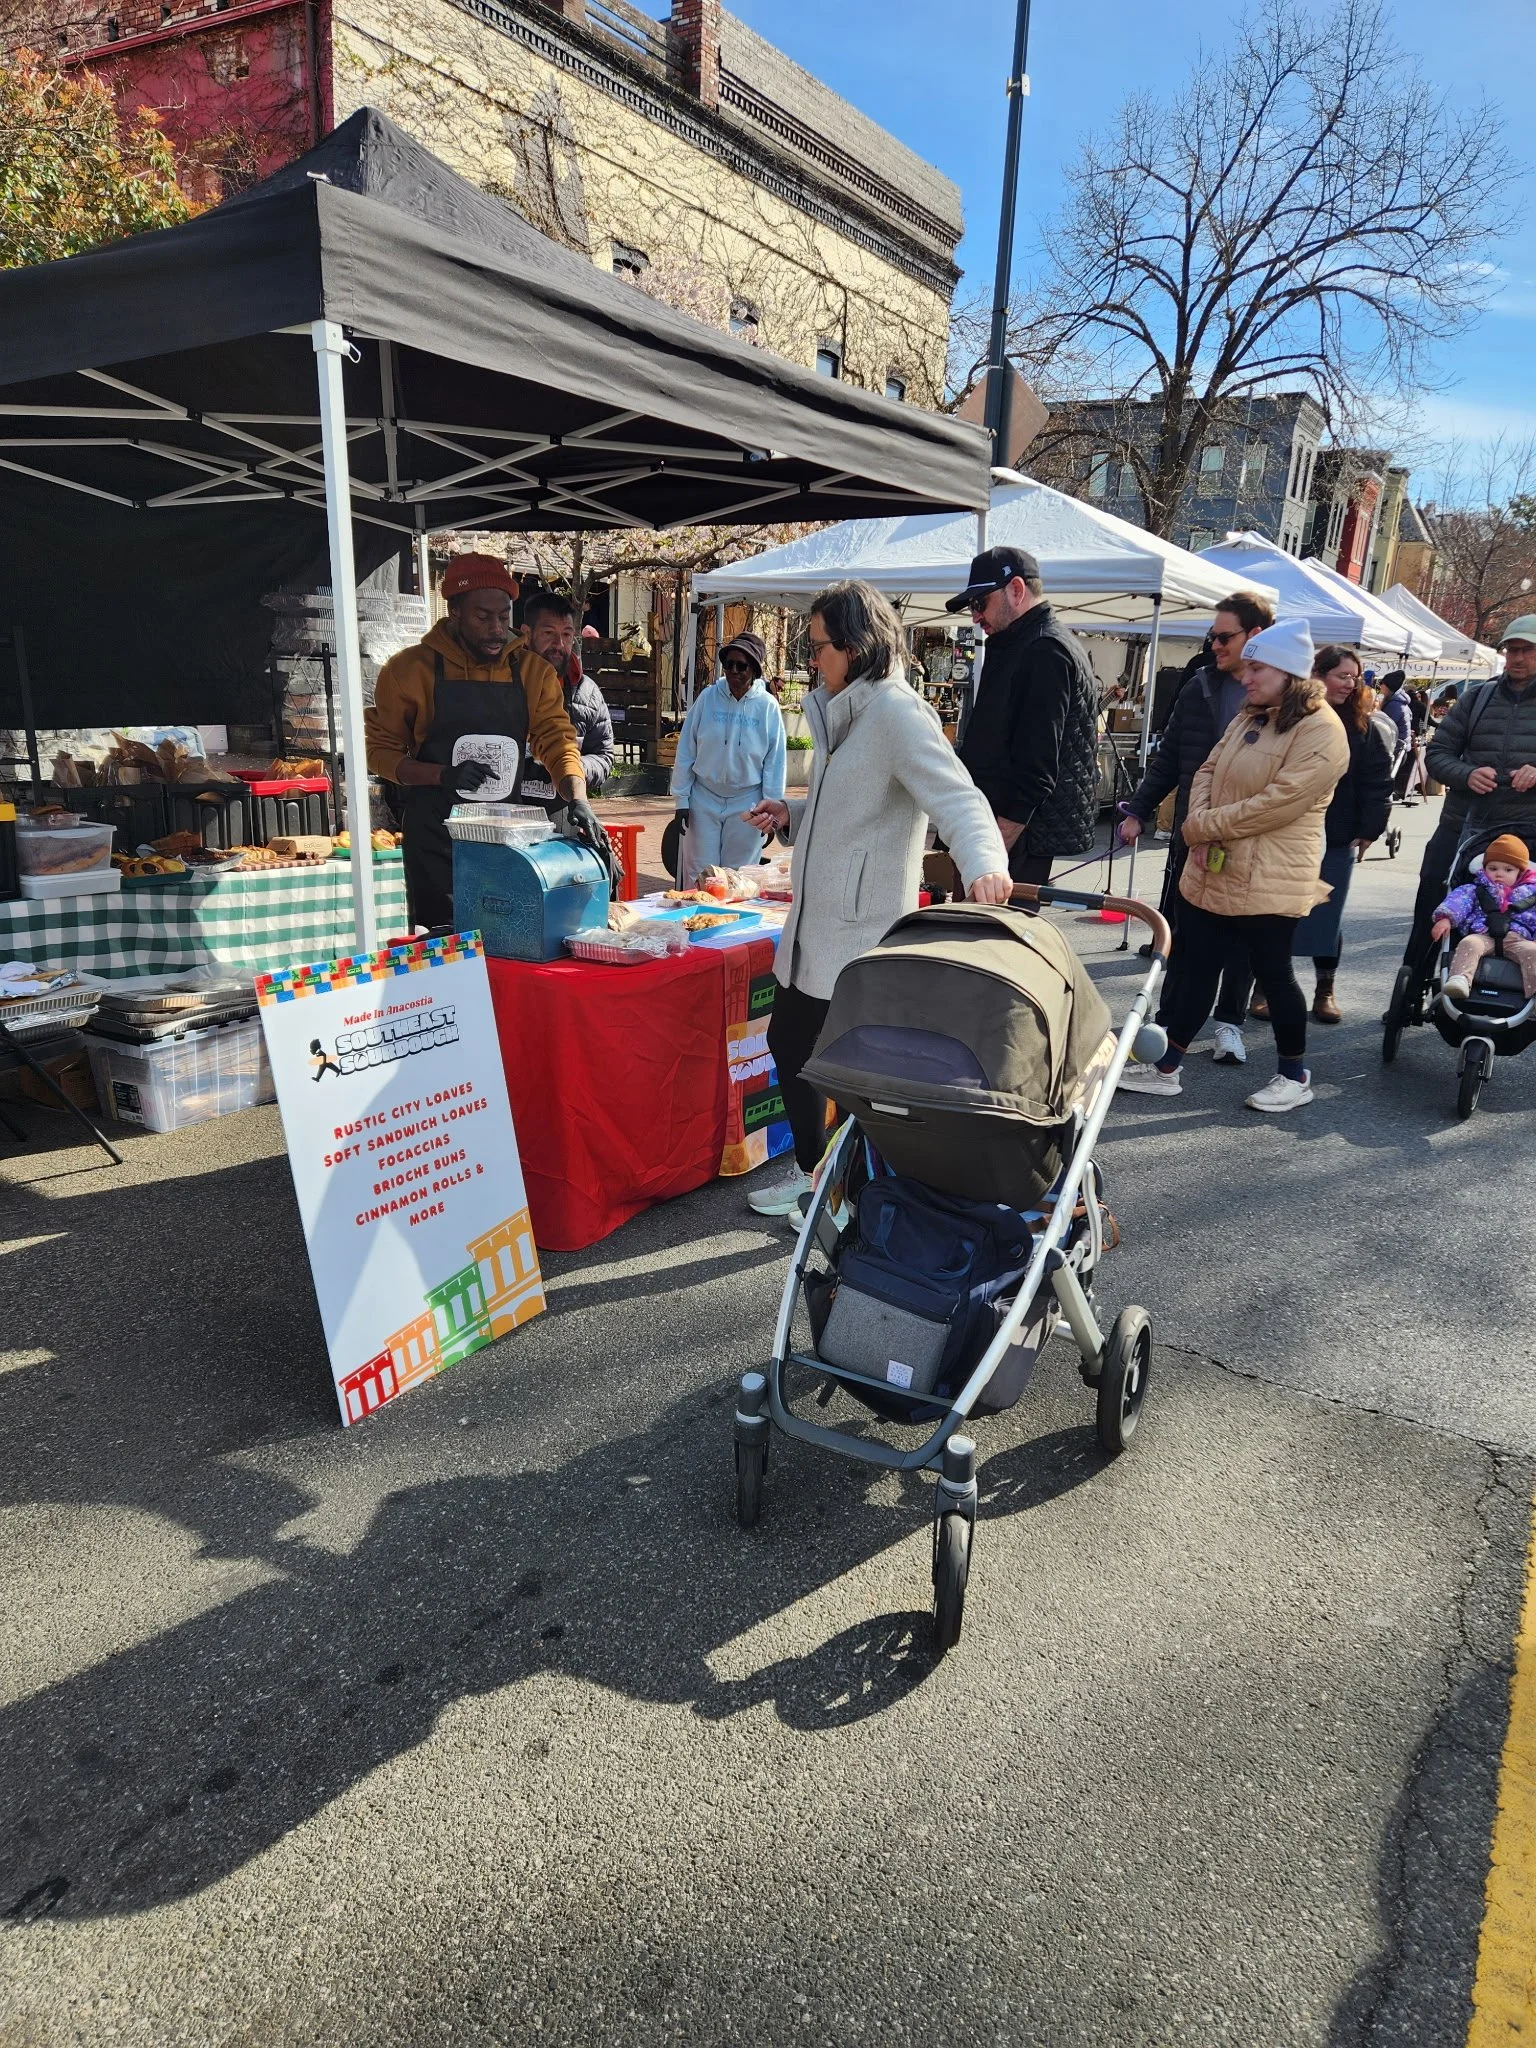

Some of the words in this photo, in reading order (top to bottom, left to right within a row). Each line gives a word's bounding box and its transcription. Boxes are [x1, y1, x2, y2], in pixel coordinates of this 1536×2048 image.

[335, 1005, 456, 1056] SOUTHEAST
[343, 1012, 372, 1027] Made
[374, 1008, 384, 1019] In
[386, 996, 433, 1016] Anacostia
[339, 1023, 459, 1075] SOURDOUGH
[323, 1144, 361, 1168] SOFT
[367, 1116, 438, 1151] SANDWICH
[441, 1098, 488, 1123] LOAVES
[333, 1112, 386, 1140] RUSTIC
[391, 1100, 421, 1119] CITY
[425, 1082, 473, 1107] LOAVES
[373, 1163, 430, 1195] BRIOCHE
[433, 1149, 466, 1170] BUNS
[377, 1133, 451, 1170] FOCACCIAS
[355, 1186, 428, 1226] CINNAMON
[432, 1168, 471, 1193] ROLLS
[475, 1163, 484, 1174] &
[409, 1201, 445, 1226] MORE
